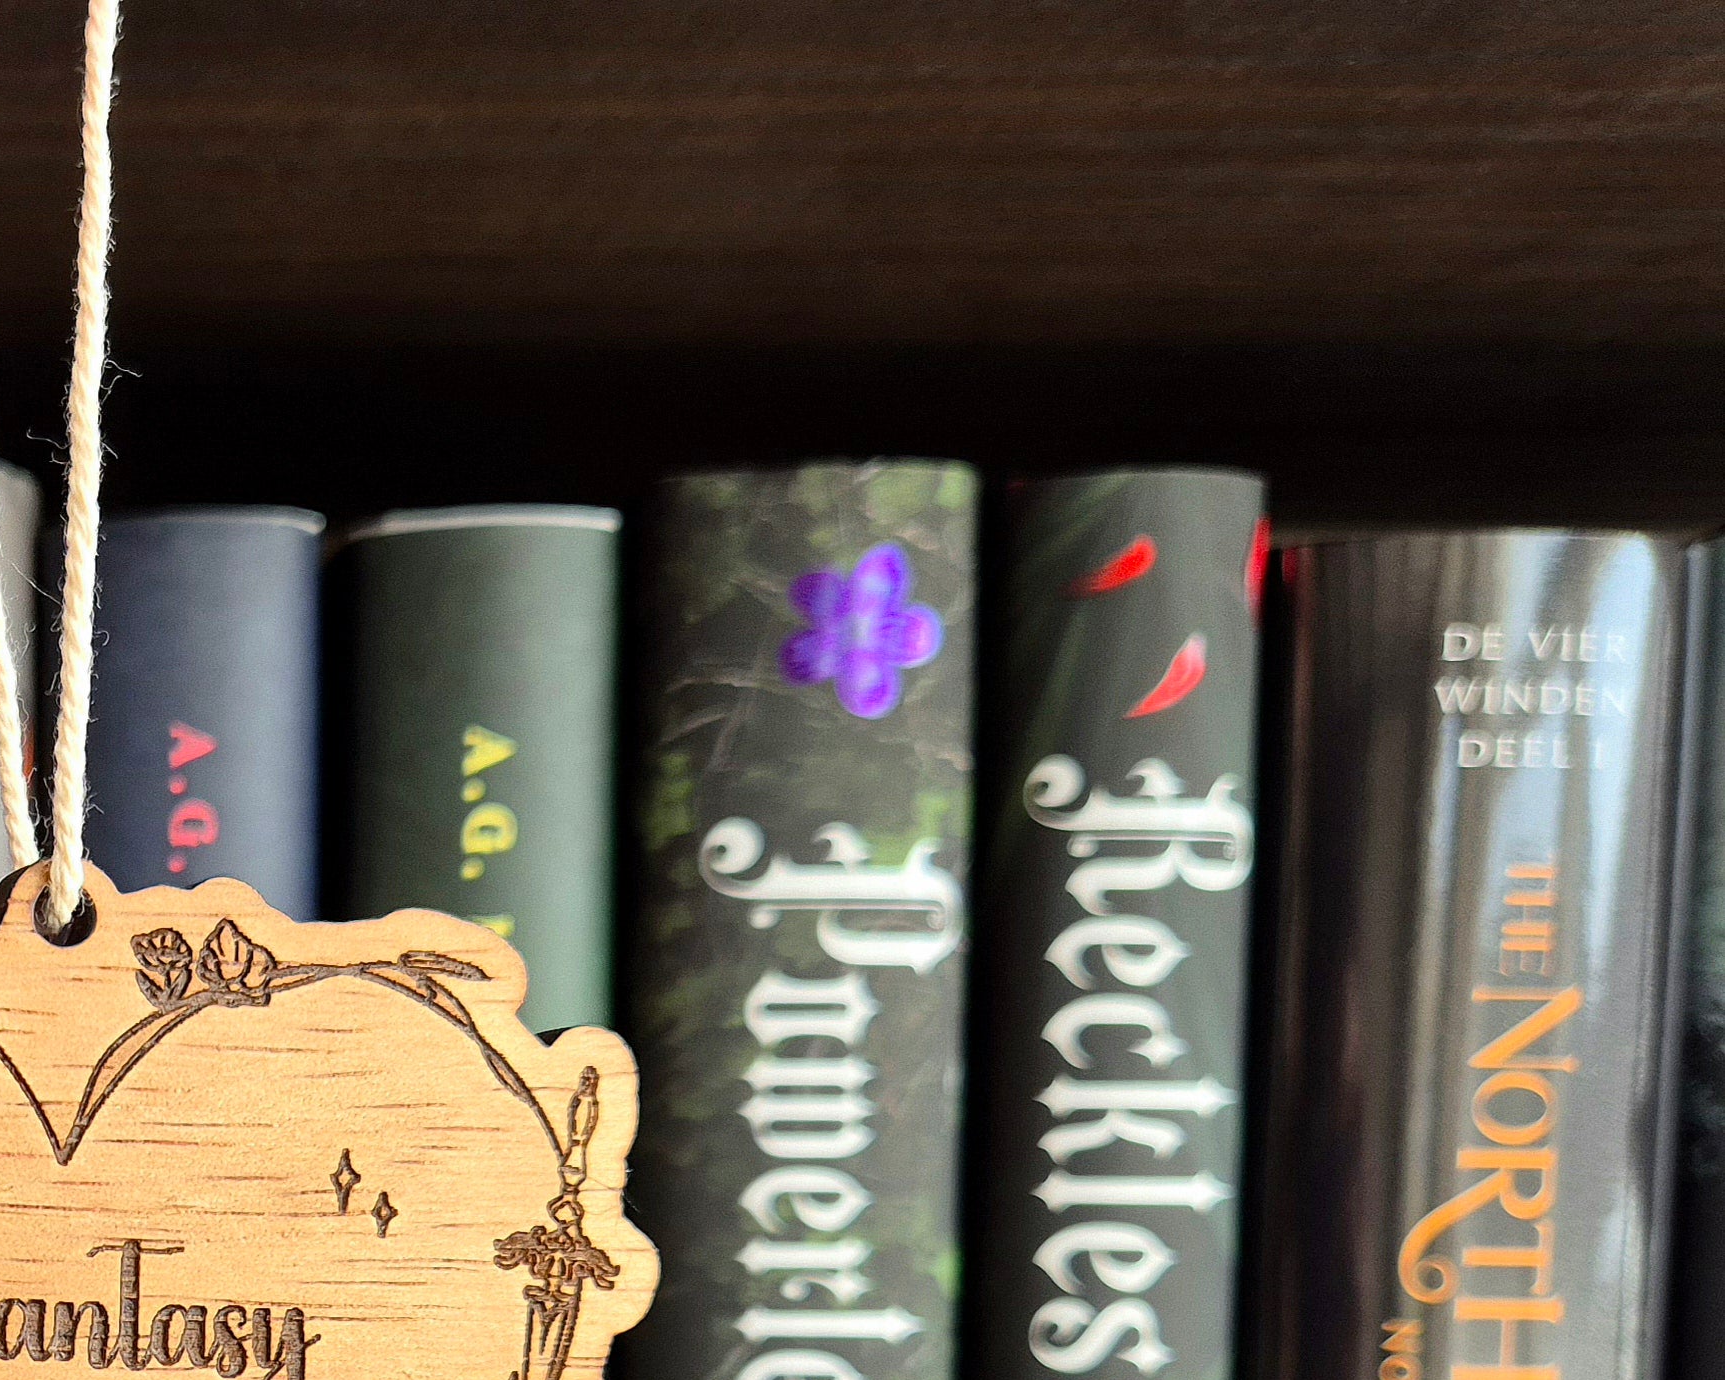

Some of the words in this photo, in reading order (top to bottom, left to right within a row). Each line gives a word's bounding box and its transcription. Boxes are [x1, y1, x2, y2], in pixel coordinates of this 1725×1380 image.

[1441, 622, 1505, 662] DE
[1528, 622, 1627, 663] VIER
[1433, 676, 1631, 716] WINDEN
[1457, 730, 1572, 768] DEEL
[1500, 855, 1559, 976] THE
